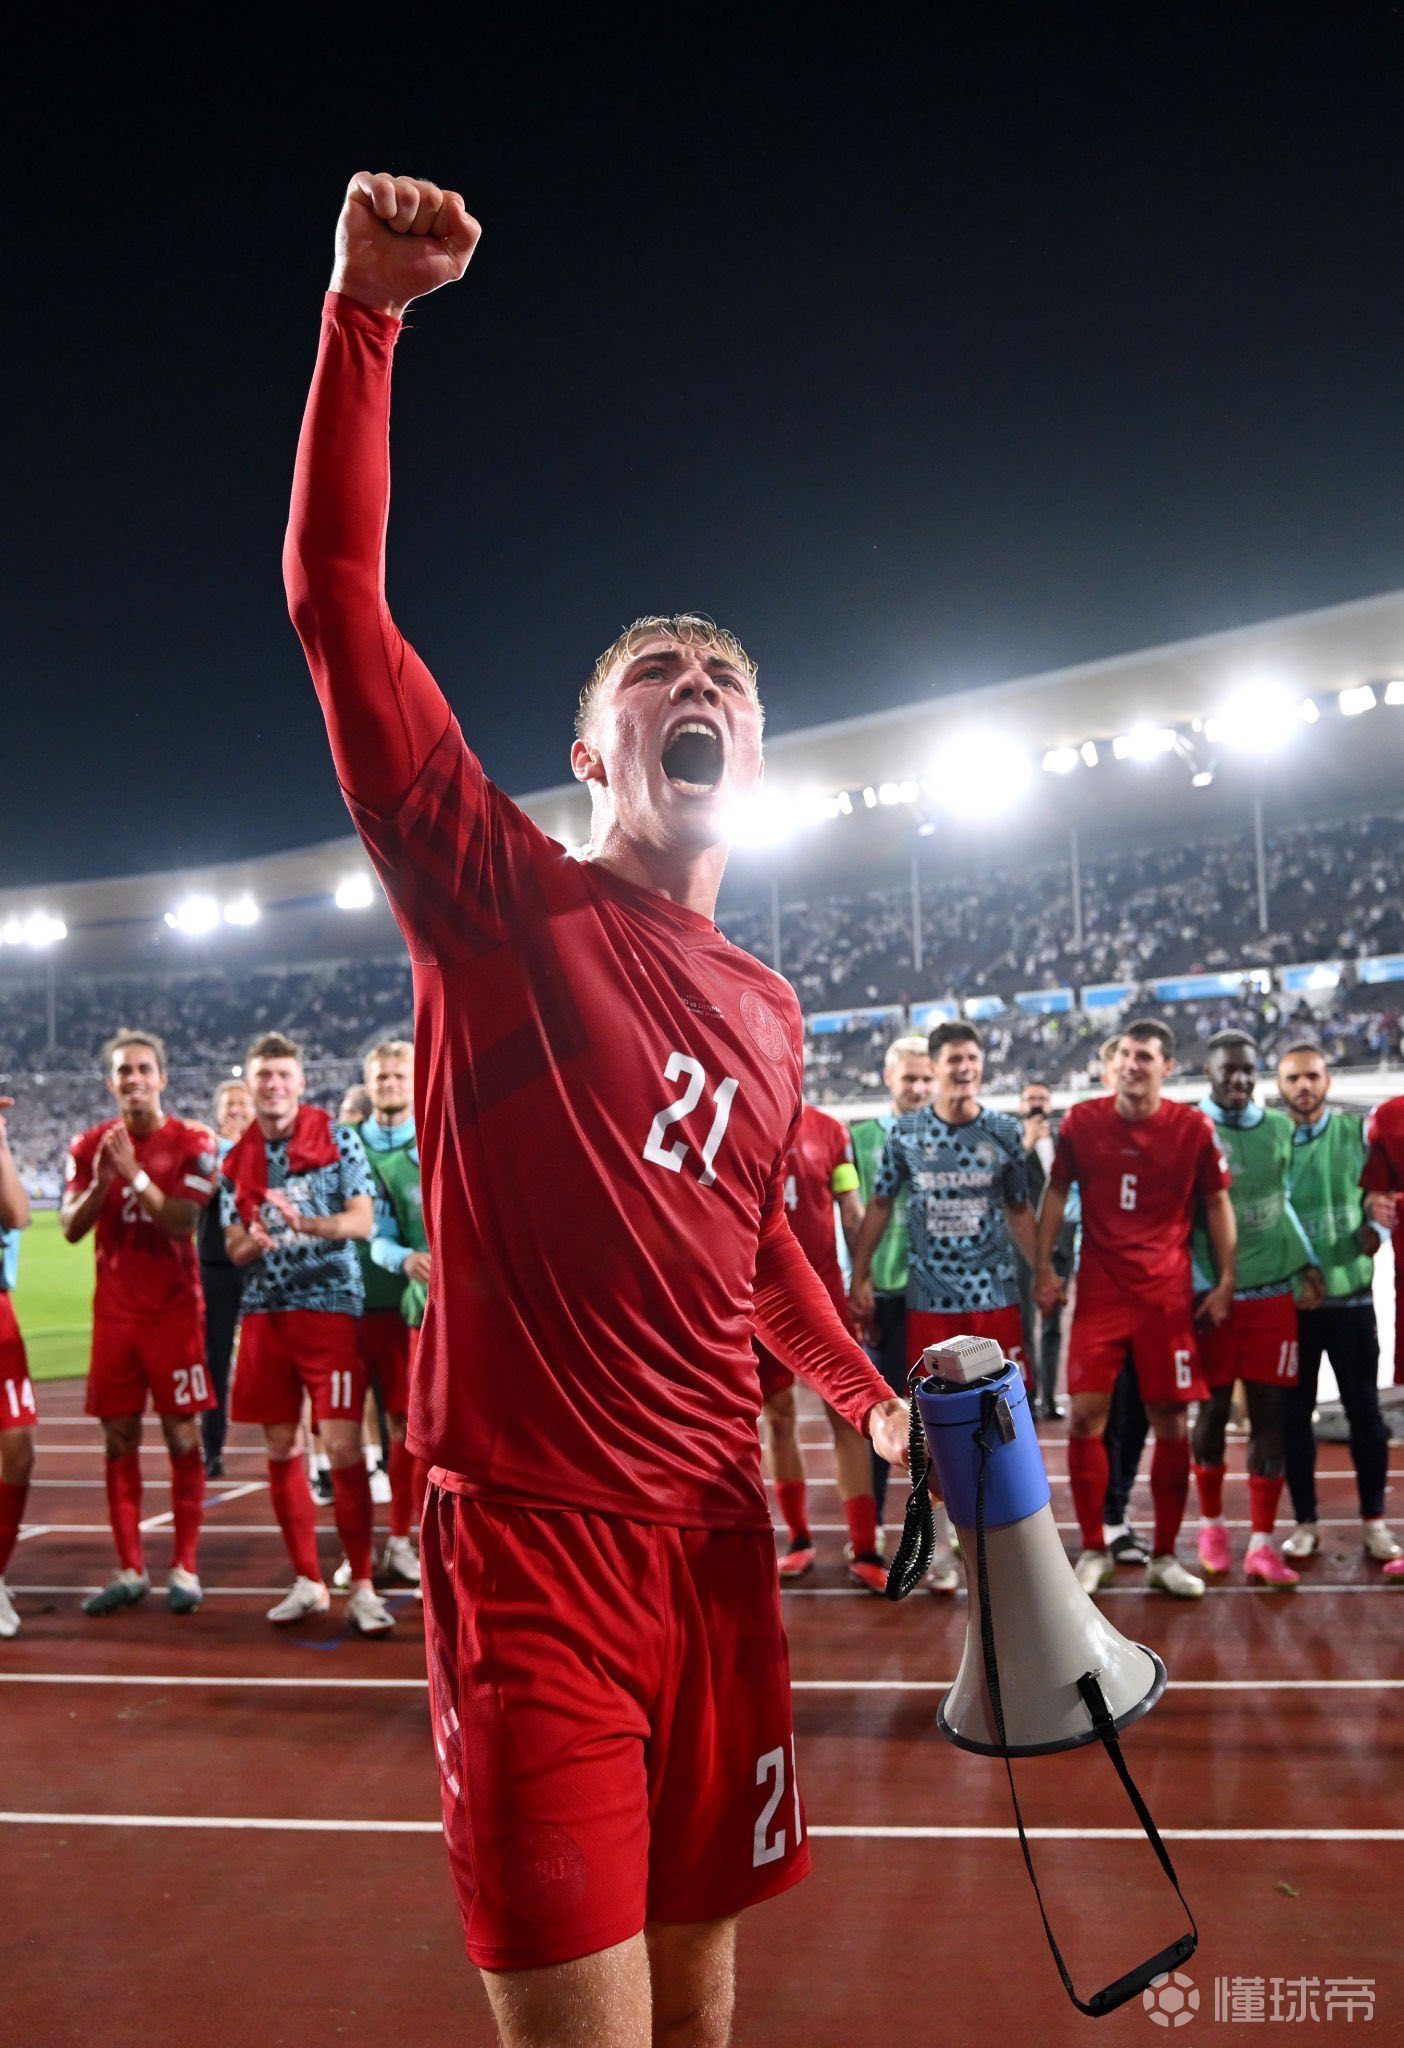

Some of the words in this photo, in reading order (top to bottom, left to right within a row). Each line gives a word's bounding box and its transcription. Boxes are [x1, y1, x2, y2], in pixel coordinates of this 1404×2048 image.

[642, 1051, 739, 1186] 21
[1120, 1174, 1137, 1211] 6
[172, 1363, 208, 1406] 20
[331, 1369, 352, 1409] 11
[1174, 1350, 1192, 1389] 6
[5, 1376, 36, 1418] 14
